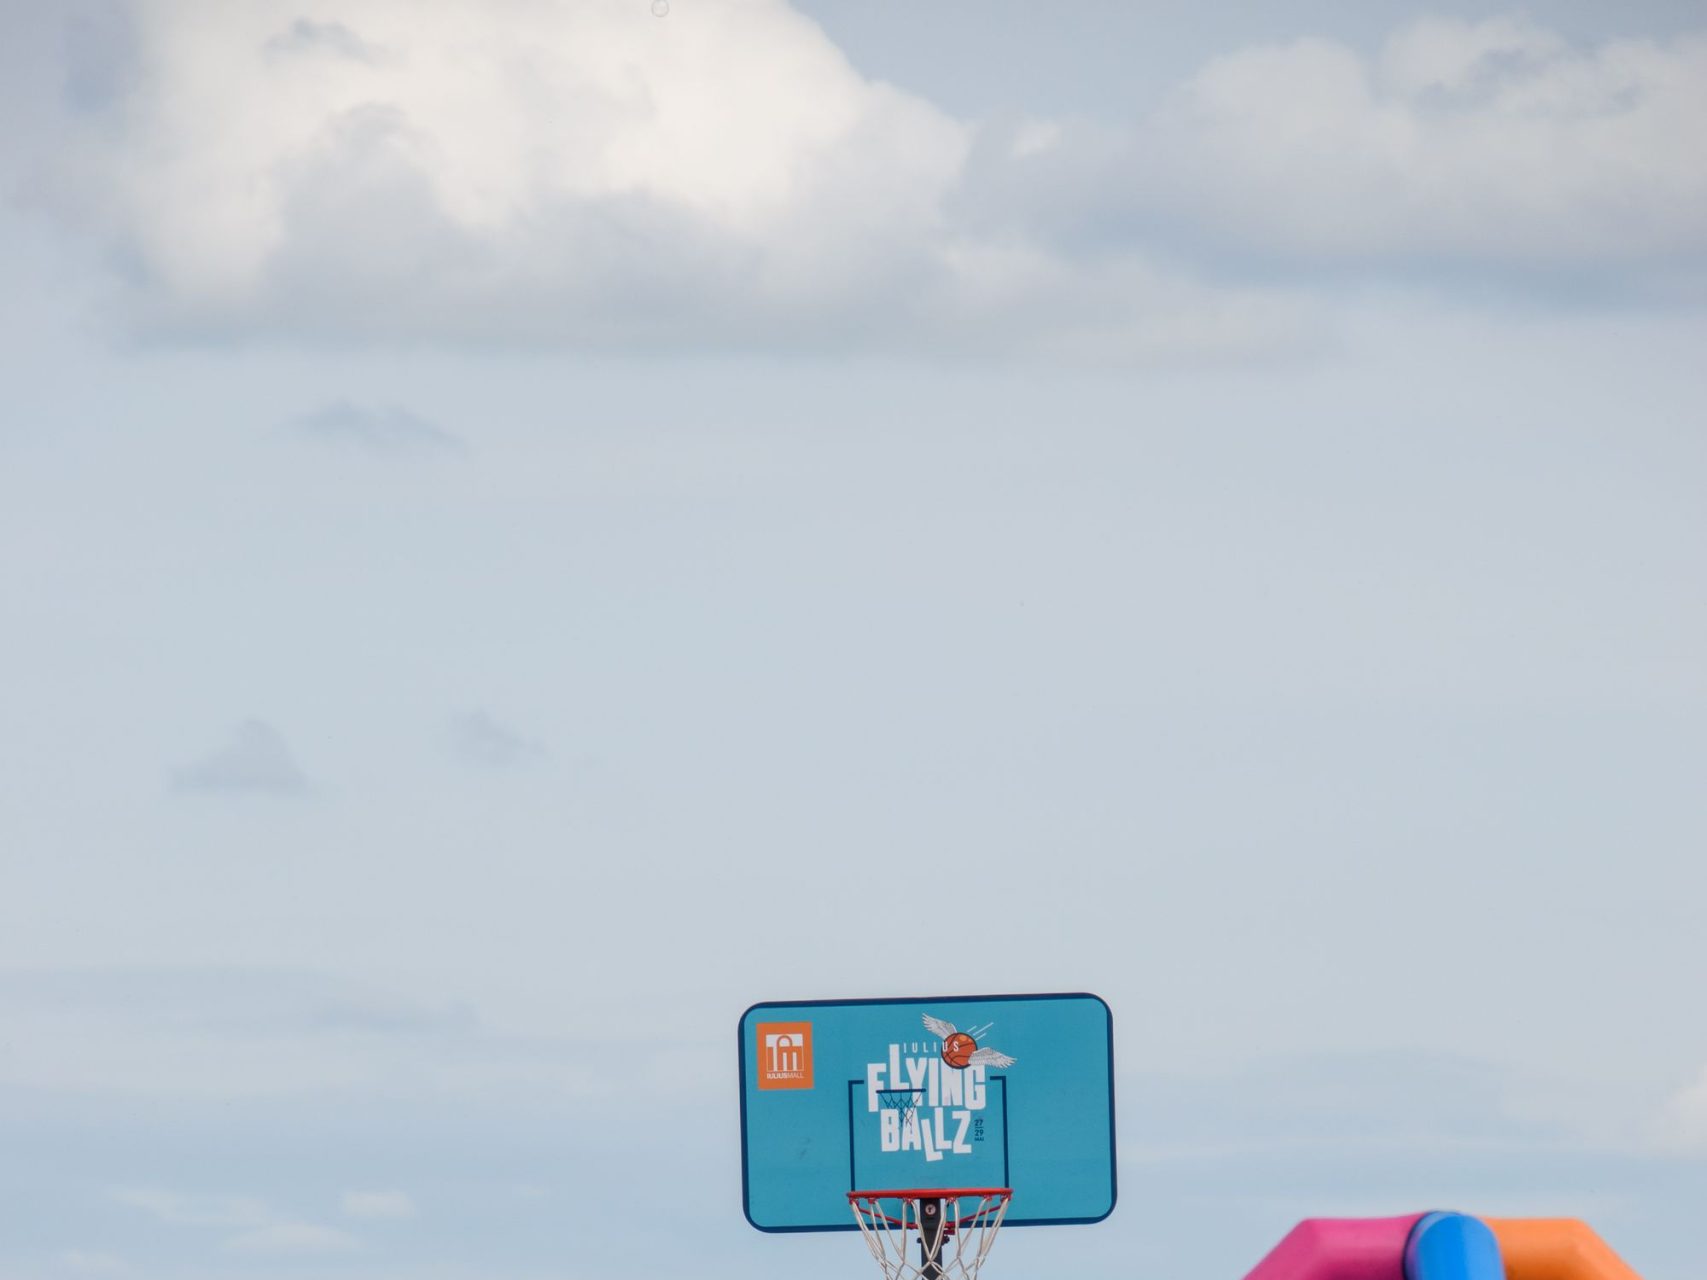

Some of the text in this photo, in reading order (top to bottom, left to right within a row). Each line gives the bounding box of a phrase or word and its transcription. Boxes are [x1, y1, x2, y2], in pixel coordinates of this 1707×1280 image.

[903, 1041, 960, 1054] IULIUS
[867, 1043, 986, 1112] FLYING
[880, 1107, 973, 1162] BALLZ
